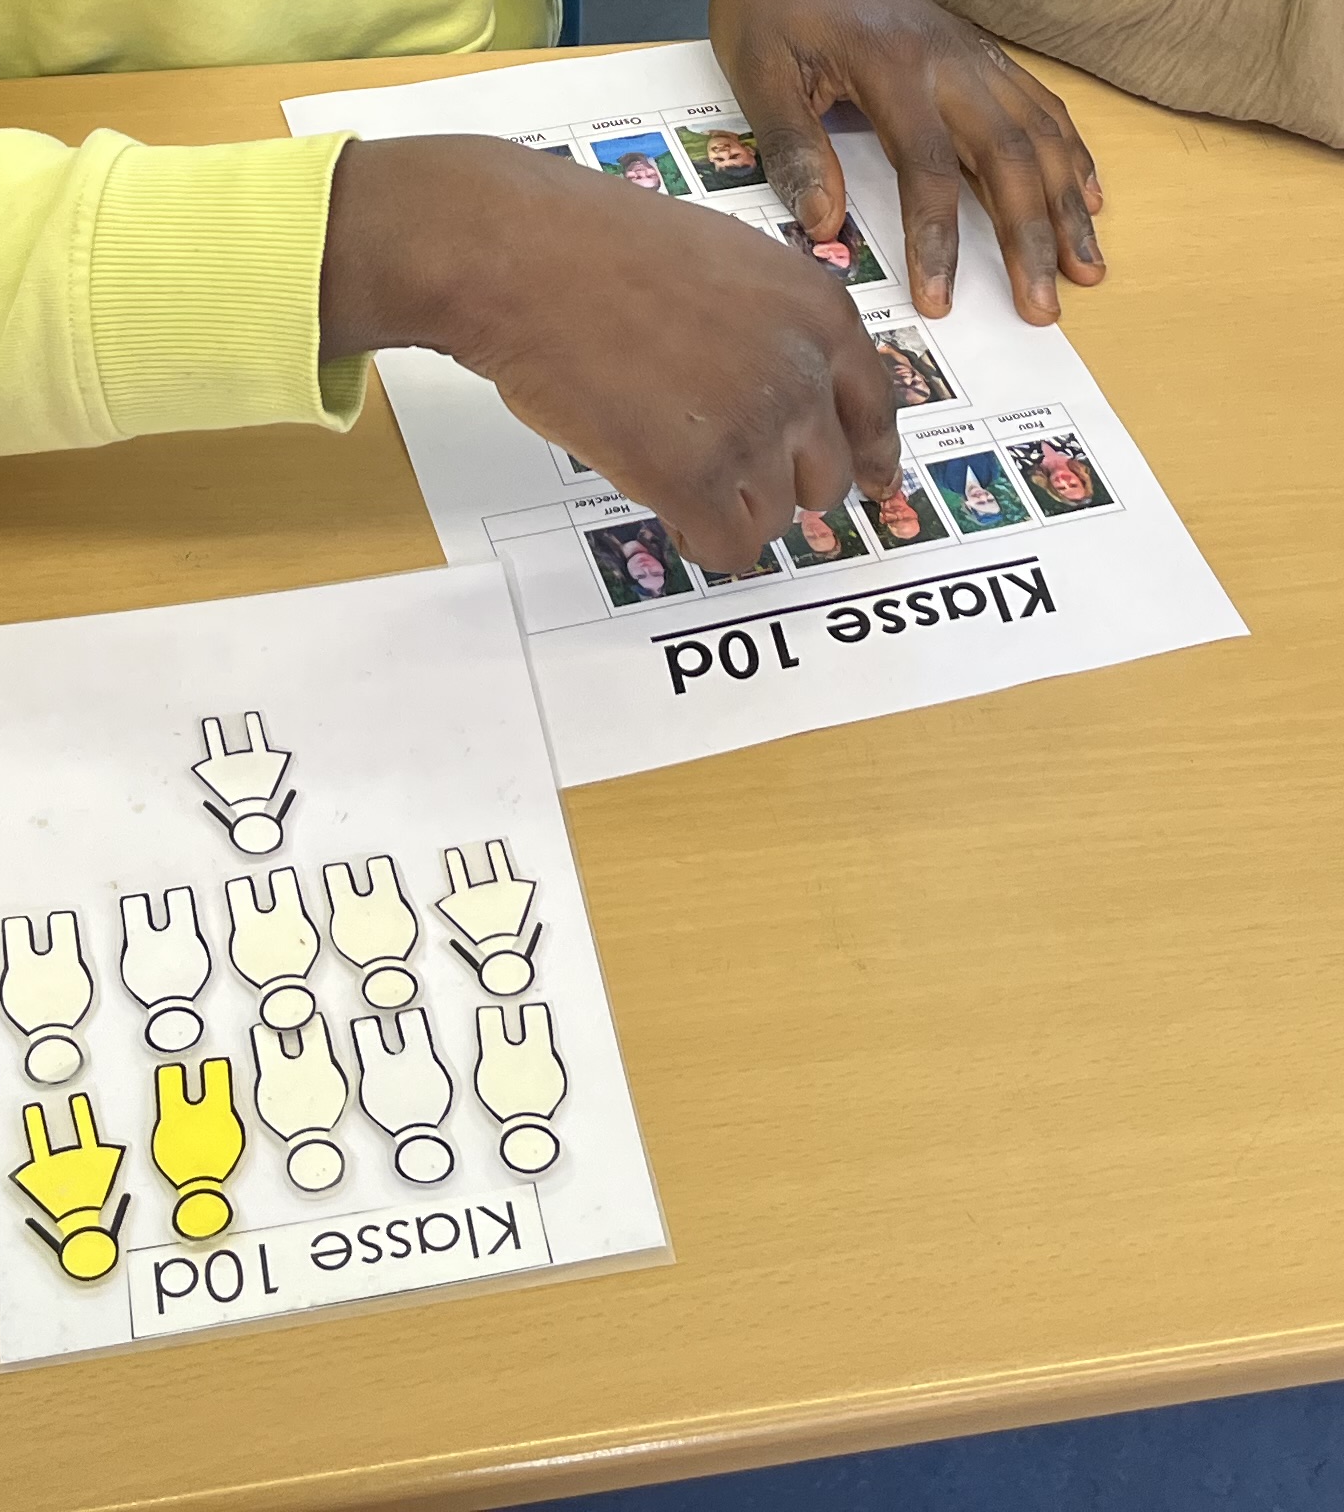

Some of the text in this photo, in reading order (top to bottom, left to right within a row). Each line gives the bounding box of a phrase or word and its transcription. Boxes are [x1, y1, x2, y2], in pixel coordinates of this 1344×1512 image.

[687, 104, 721, 117] Taha
[592, 116, 642, 131] Osman
[507, 133, 547, 144] Vikto
[1018, 420, 1045, 432] Frau
[938, 436, 965, 449] Frau
[604, 504, 631, 516] Herr
[664, 567, 1057, 695] Klasse 10d
[153, 1201, 521, 1315] Klasse 10d
